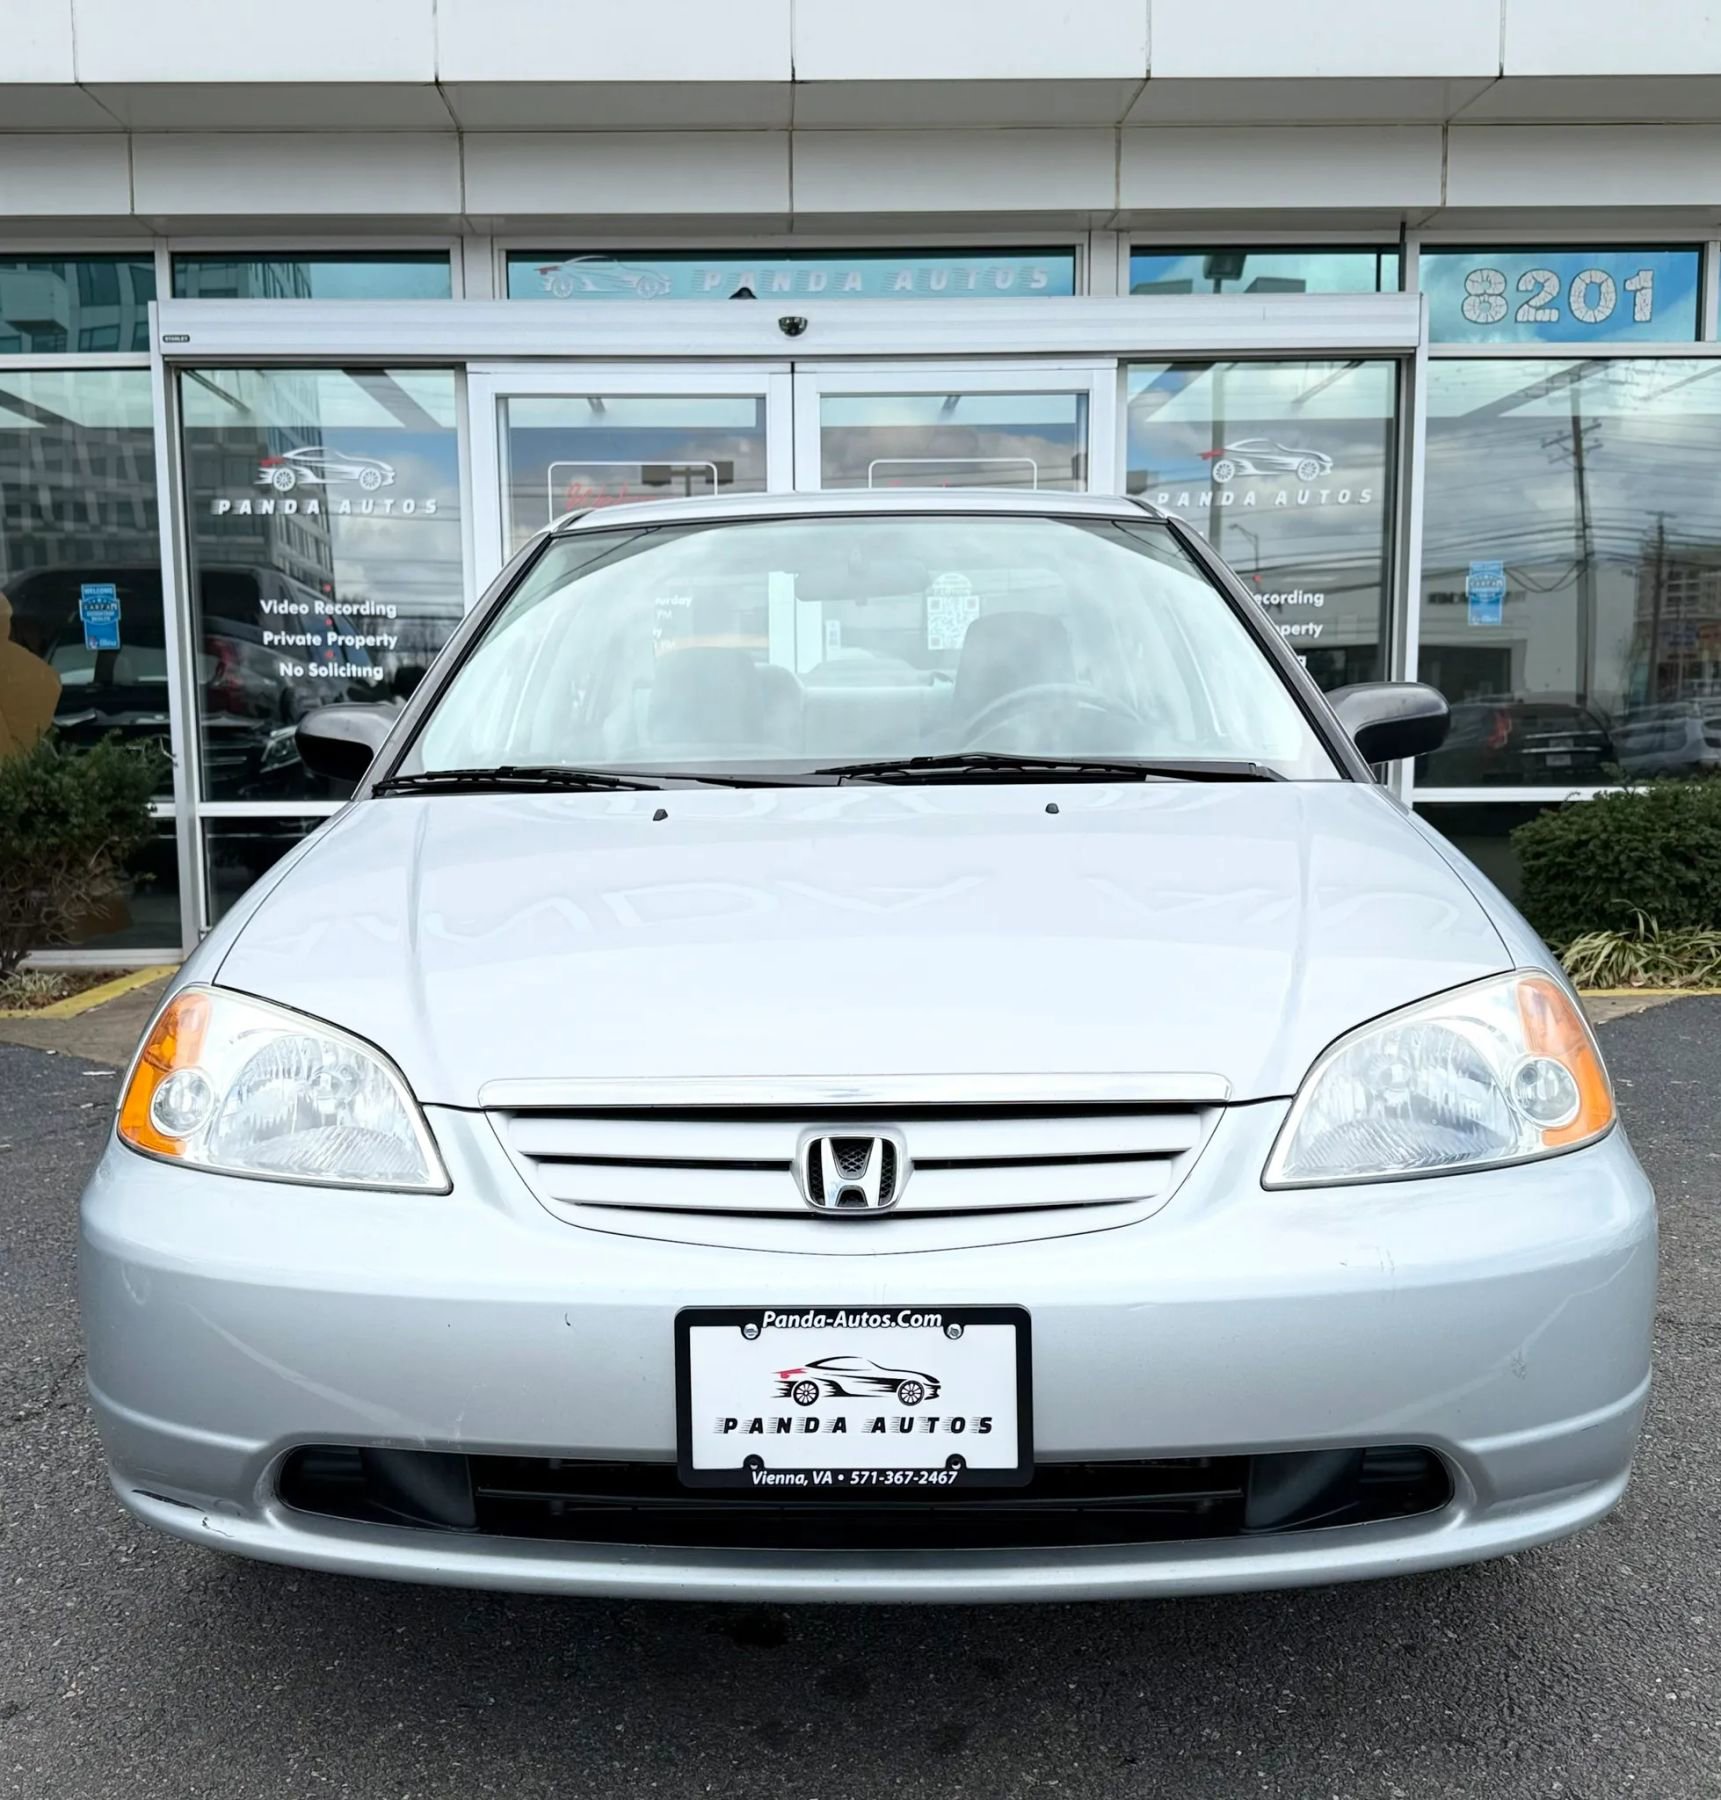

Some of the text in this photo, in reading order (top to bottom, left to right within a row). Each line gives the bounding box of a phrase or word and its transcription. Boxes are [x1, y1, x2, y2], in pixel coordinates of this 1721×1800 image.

[694, 266, 1049, 293] PANDA AUTOS
[1460, 267, 1654, 325] 8201
[1155, 488, 1373, 507] PANDA AUTOS
[212, 498, 438, 516] PANDA AUTOS
[1252, 590, 1325, 607] ecording
[260, 599, 397, 620] Video Recording
[1276, 622, 1324, 639] perty
[263, 631, 398, 650] Private Property
[279, 662, 384, 680] No Soliciting
[762, 1309, 943, 1329] Panda-Autos.Com
[713, 1416, 993, 1434] PANDA AUTOS
[751, 1470, 958, 1487] Vienna, VA 571-367-2467
